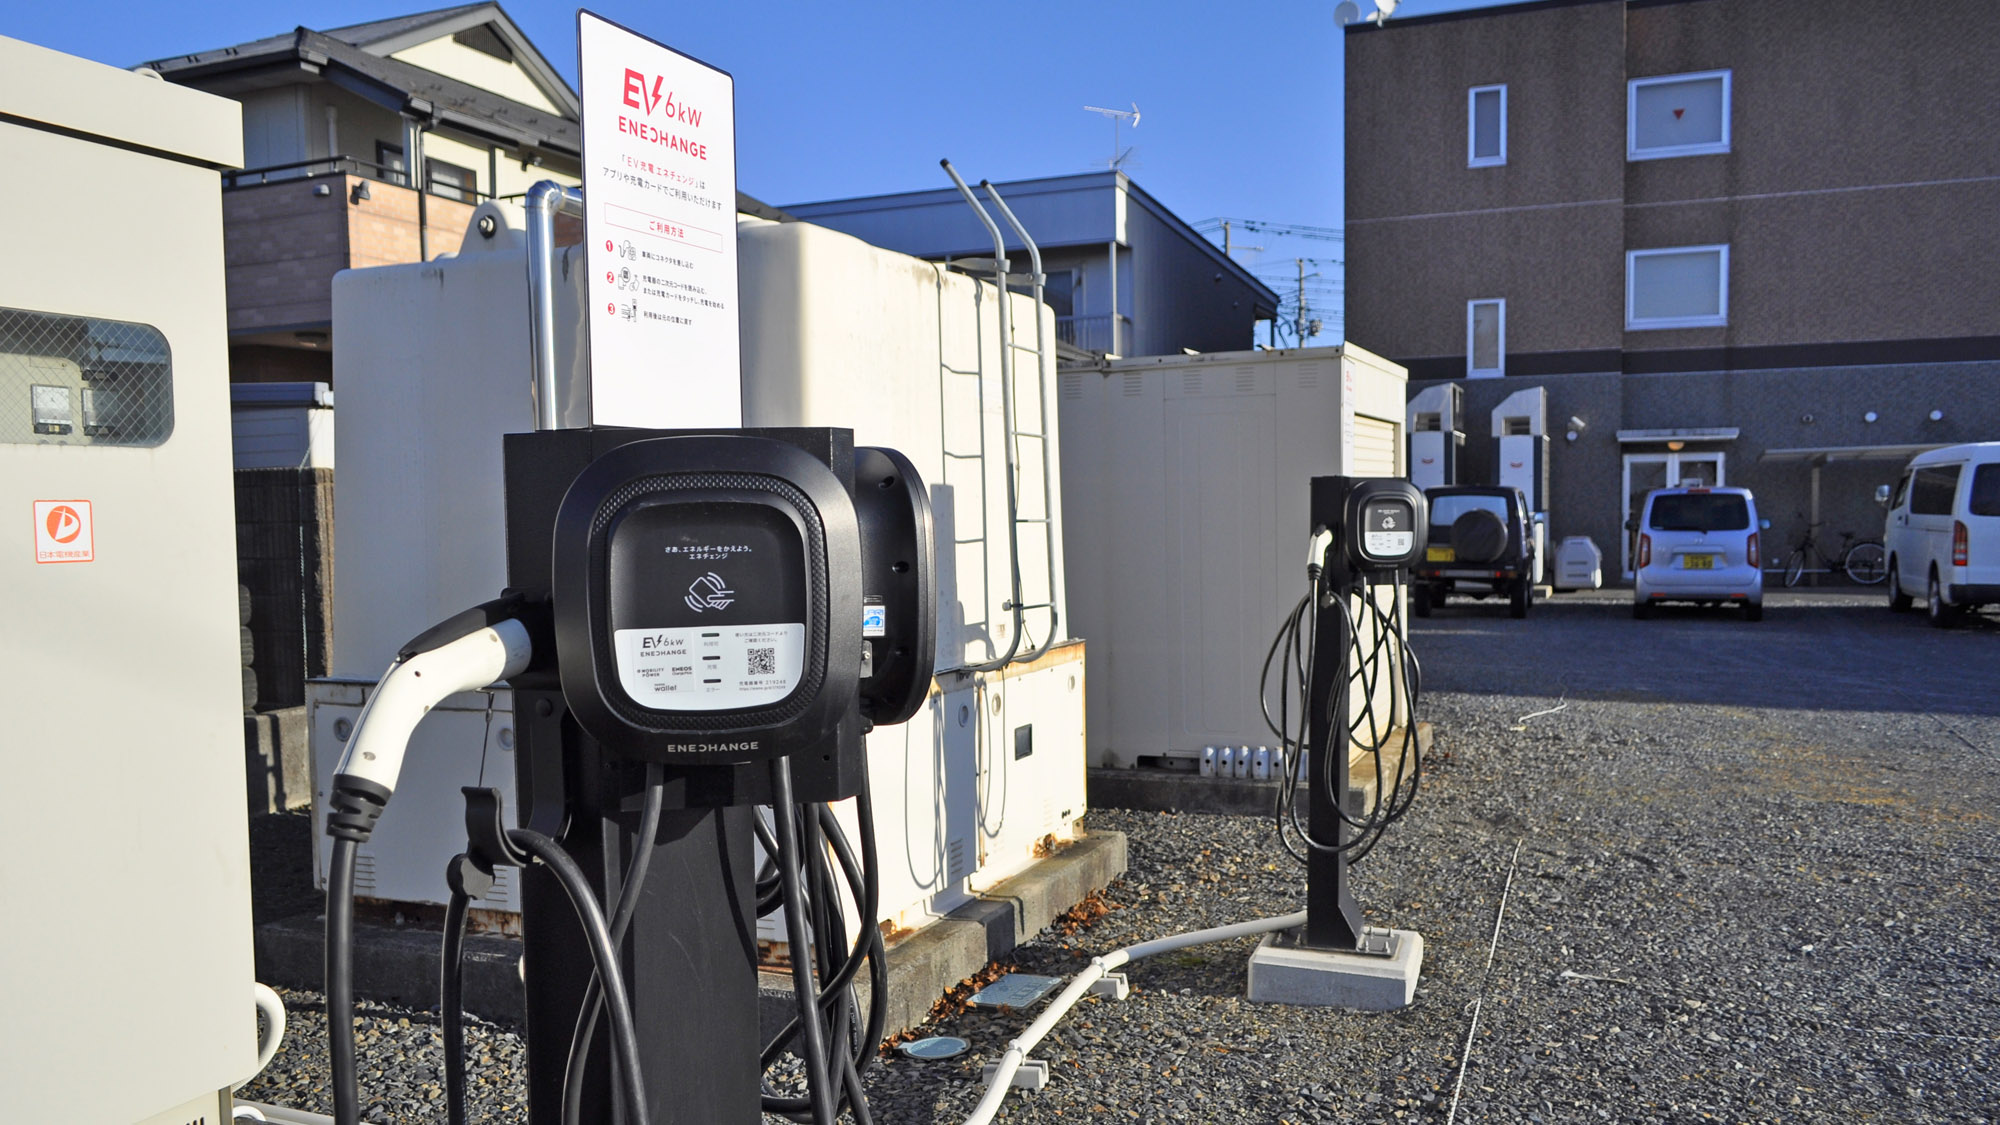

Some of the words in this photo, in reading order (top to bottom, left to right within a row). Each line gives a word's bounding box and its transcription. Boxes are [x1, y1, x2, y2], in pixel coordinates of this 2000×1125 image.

[602, 167, 722, 211] アプリや充電カードでご利用いただけます
[649, 220, 684, 238] ご利用方法
